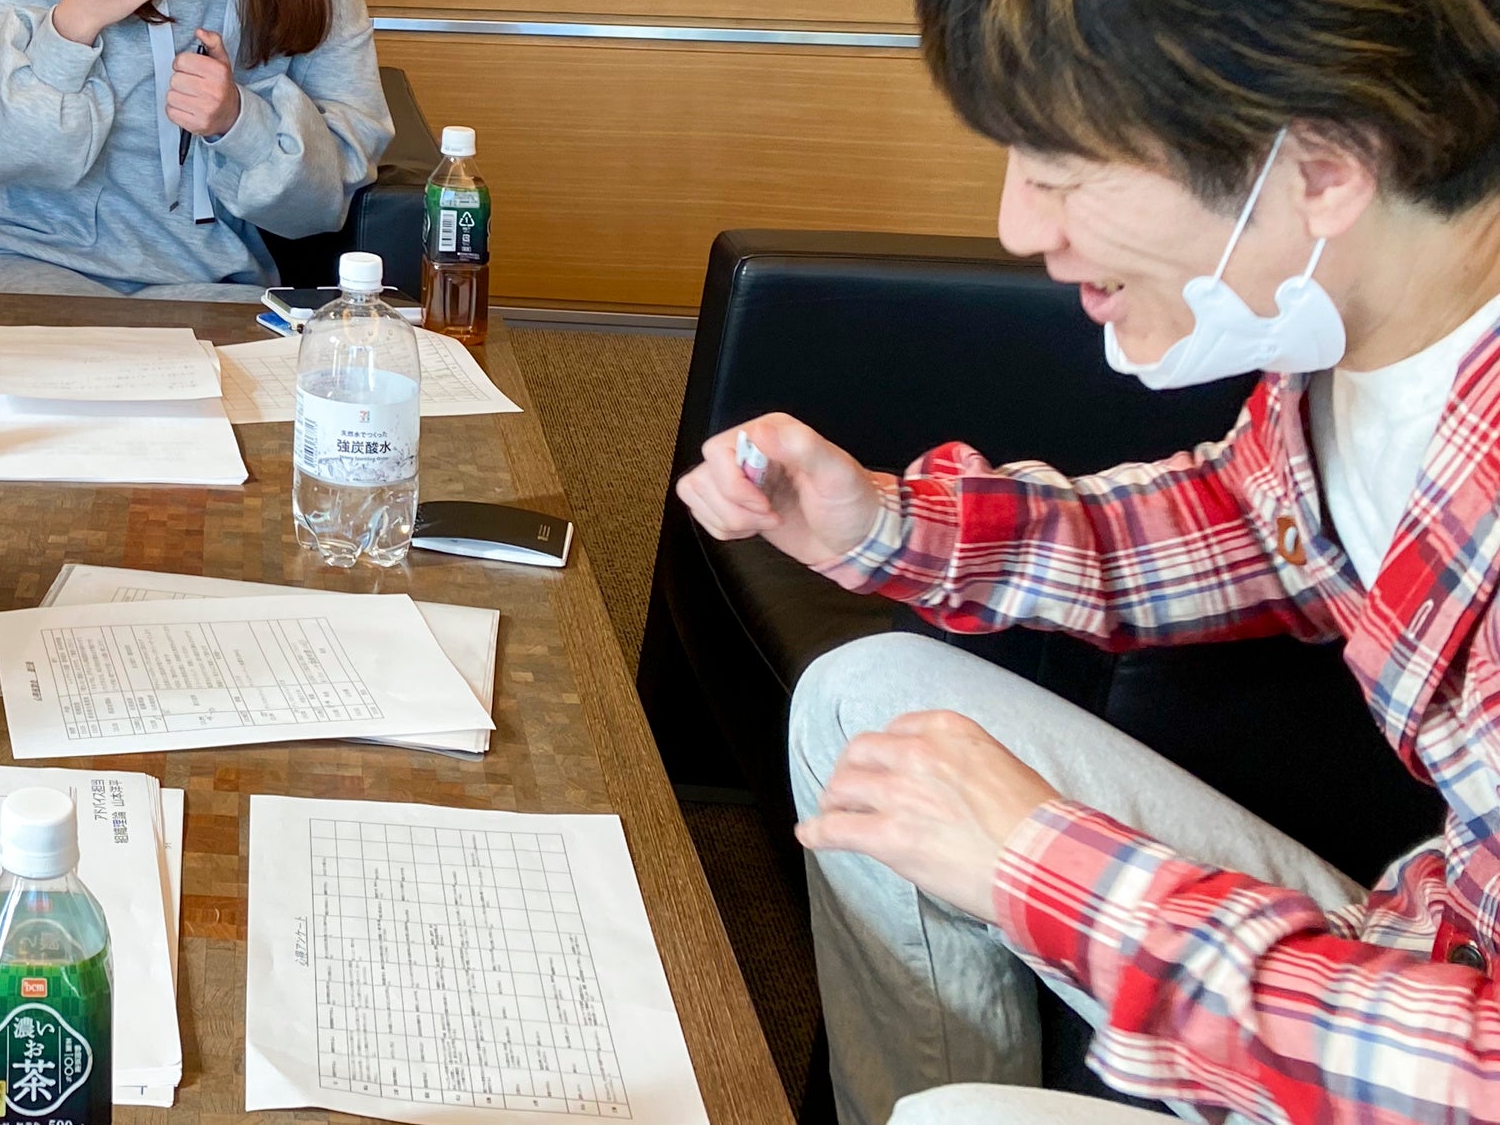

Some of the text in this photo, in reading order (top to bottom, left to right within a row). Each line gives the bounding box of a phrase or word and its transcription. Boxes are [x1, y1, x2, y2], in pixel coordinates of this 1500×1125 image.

[336, 438, 392, 455] 強炭酸水
[13, 1016, 56, 1039] 濃い
